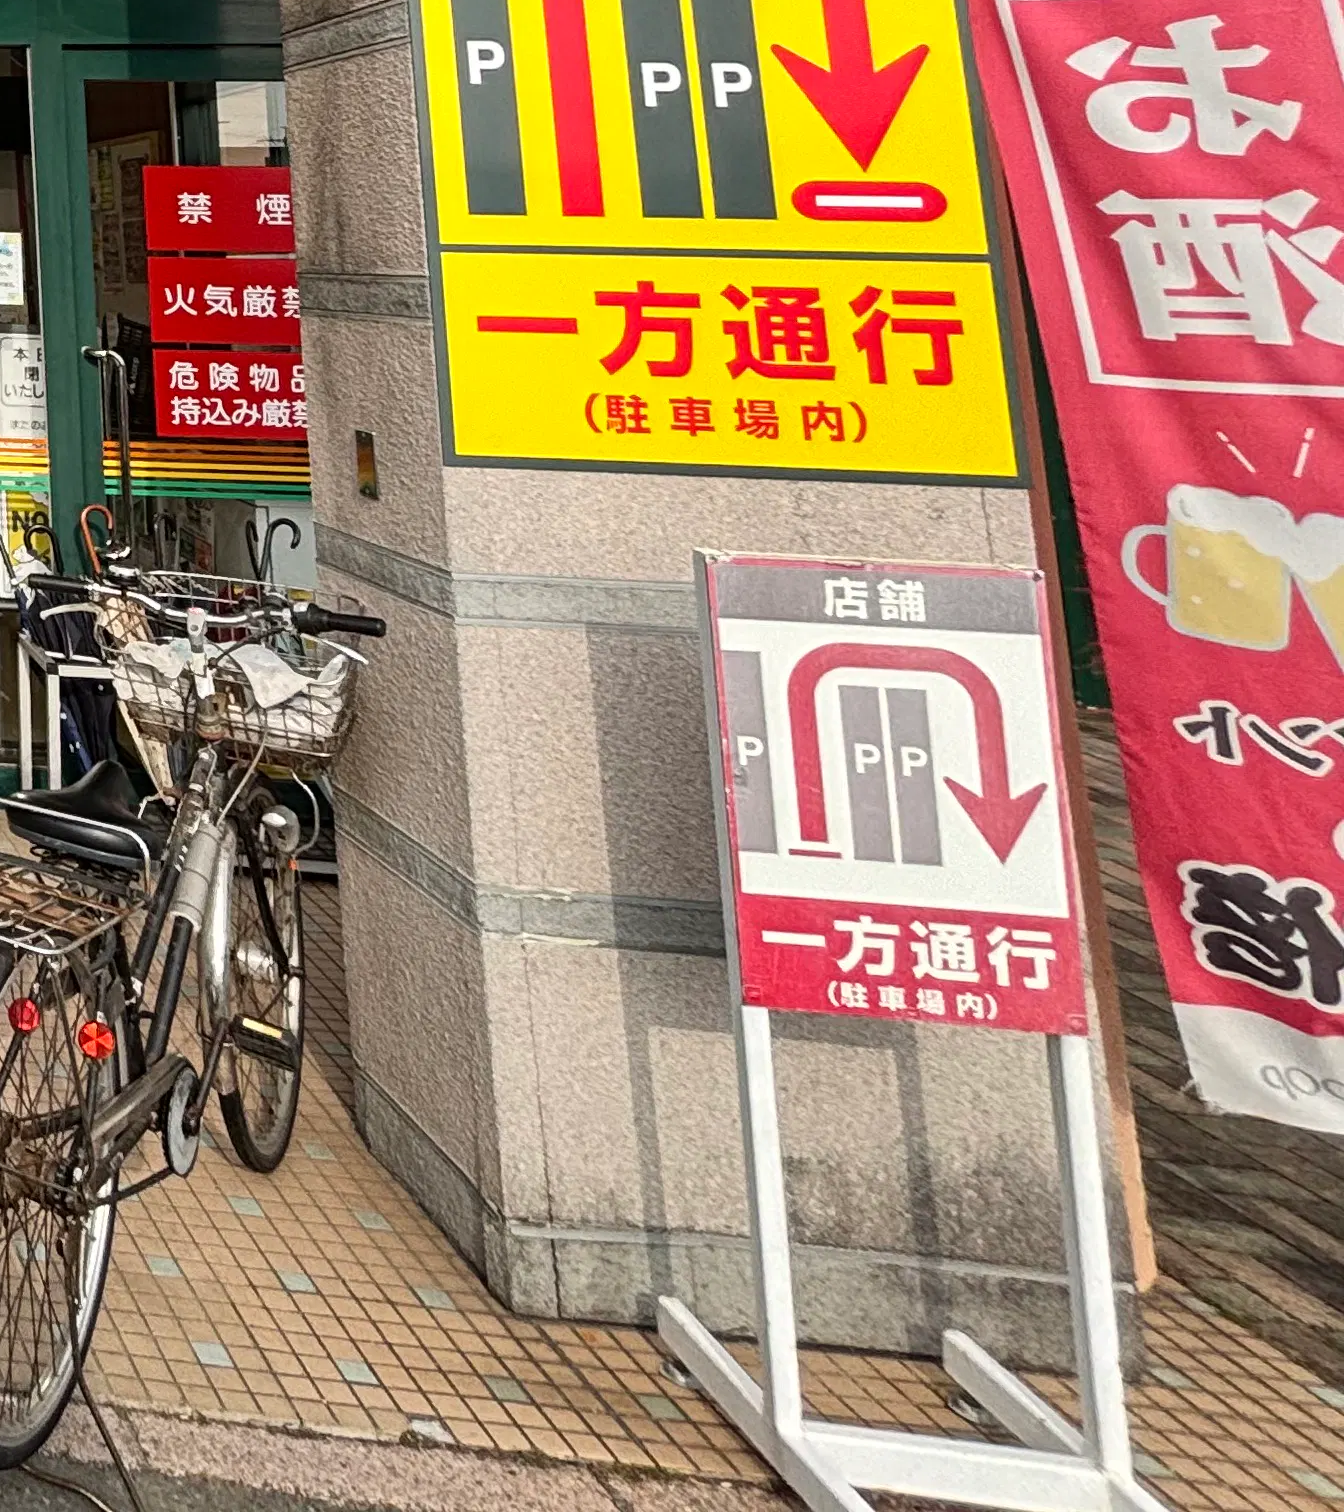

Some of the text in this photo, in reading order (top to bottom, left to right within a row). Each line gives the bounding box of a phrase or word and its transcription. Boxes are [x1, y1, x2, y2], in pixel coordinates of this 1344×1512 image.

[465, 39, 506, 86] P
[640, 61, 682, 108] P
[711, 61, 753, 109] P
[176, 191, 293, 226] 禁煙
[476, 280, 965, 386] 一方通行
[583, 392, 868, 445] (駐車場内)
[822, 576, 928, 624] 店舗
[735, 734, 765, 766] P
[855, 744, 882, 775] P
[901, 746, 929, 778] P
[760, 915, 1057, 989] 一方通行
[826, 981, 999, 1022] (駐車場内)
